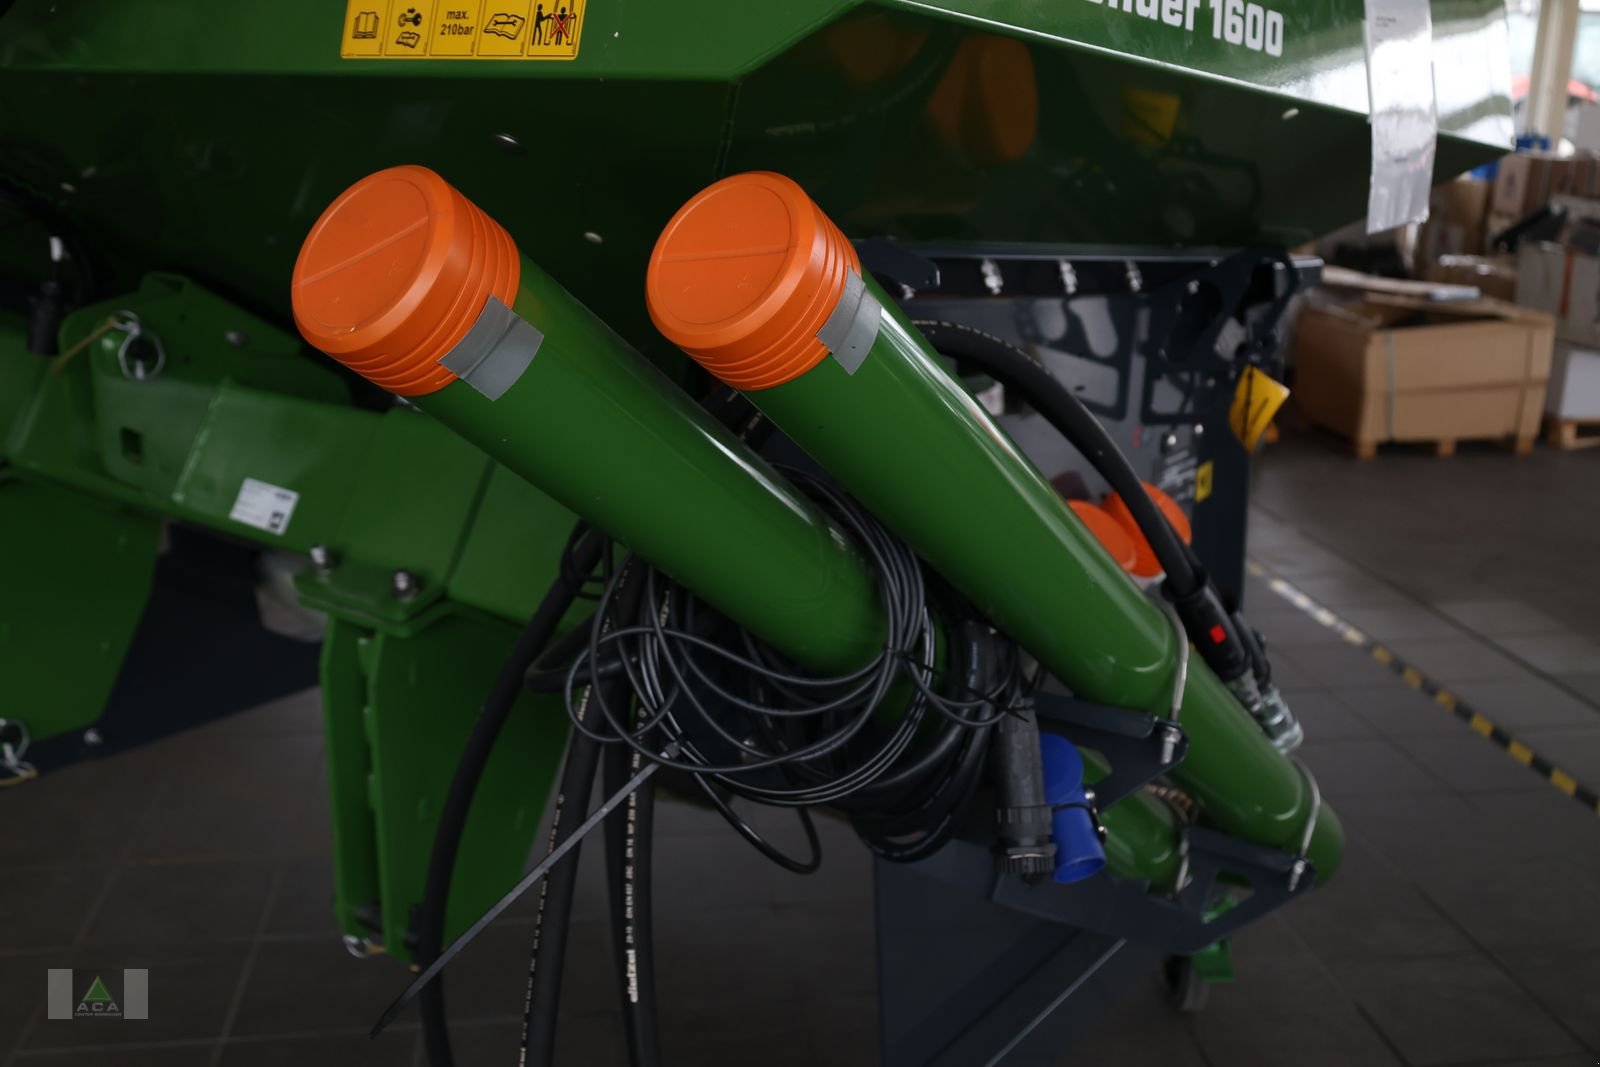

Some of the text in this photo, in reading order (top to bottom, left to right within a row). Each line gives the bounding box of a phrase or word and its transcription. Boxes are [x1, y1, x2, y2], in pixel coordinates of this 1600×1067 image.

[446, 10, 470, 20] max.
[440, 23, 474, 36] 210bar
[1209, 0, 1284, 58] 1600
